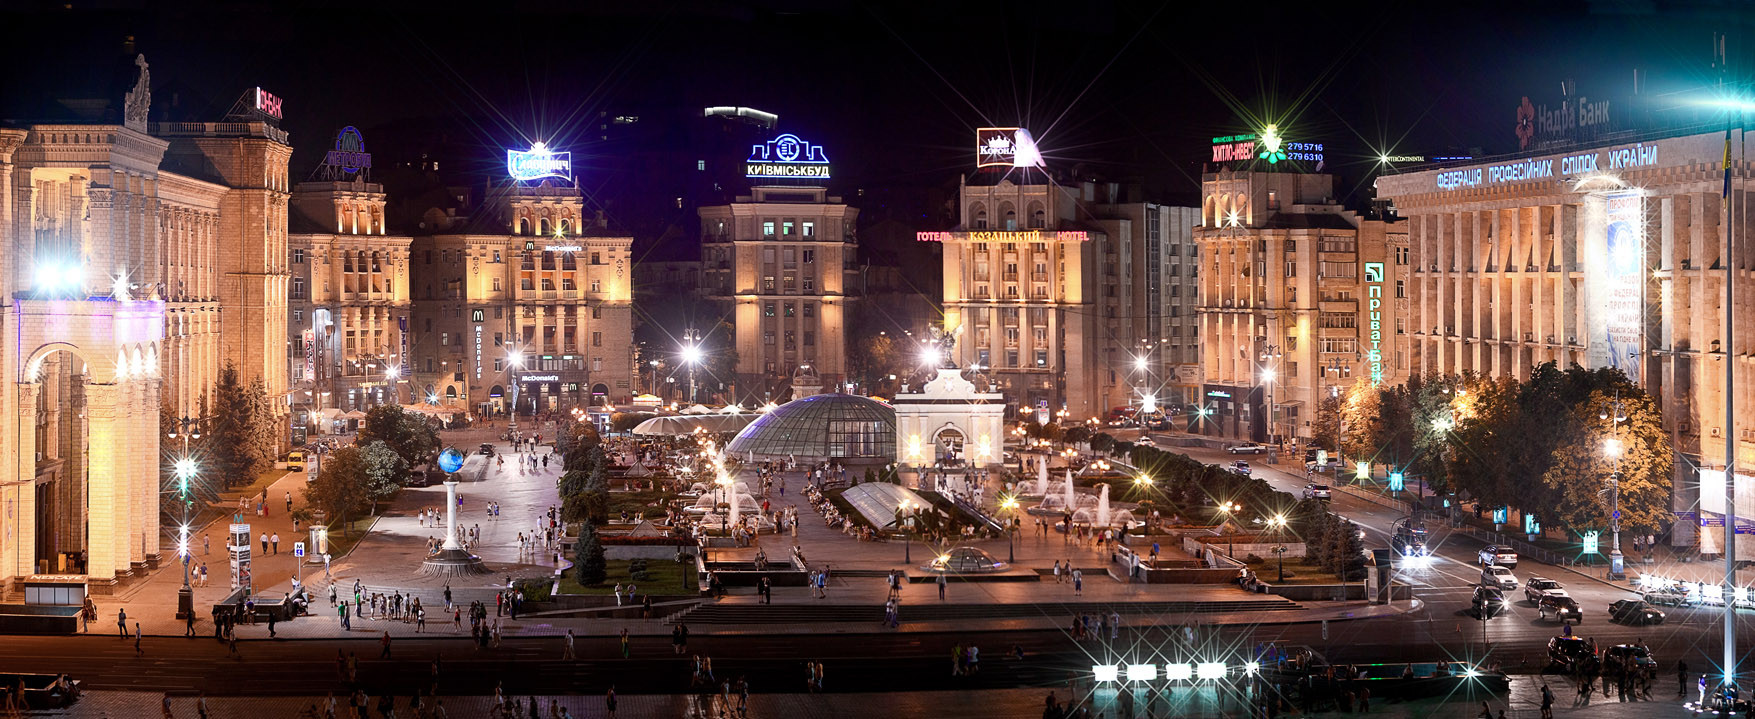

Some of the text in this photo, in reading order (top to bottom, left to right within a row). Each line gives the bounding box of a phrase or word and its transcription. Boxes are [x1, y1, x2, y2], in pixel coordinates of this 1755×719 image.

[1538, 97, 1610, 137] Надра Банк
[1213, 142, 1254, 161] ЖИТЛО-ІНВЕСТ
[1288, 142, 1323, 152] 279 5716
[1288, 152, 1323, 161] 279 6310
[747, 164, 830, 177] КИЇВМІСЬКБУД
[1437, 143, 1657, 191] ФЕДЕРАЦІЯ ПРОФЕСІЙНИХ СПІЛОК УКРАЇНИ
[916, 229, 1041, 242] ГОТЕЛЬ КОЗАЦЬКИЙ
[1057, 231, 1090, 242] HOTEL
